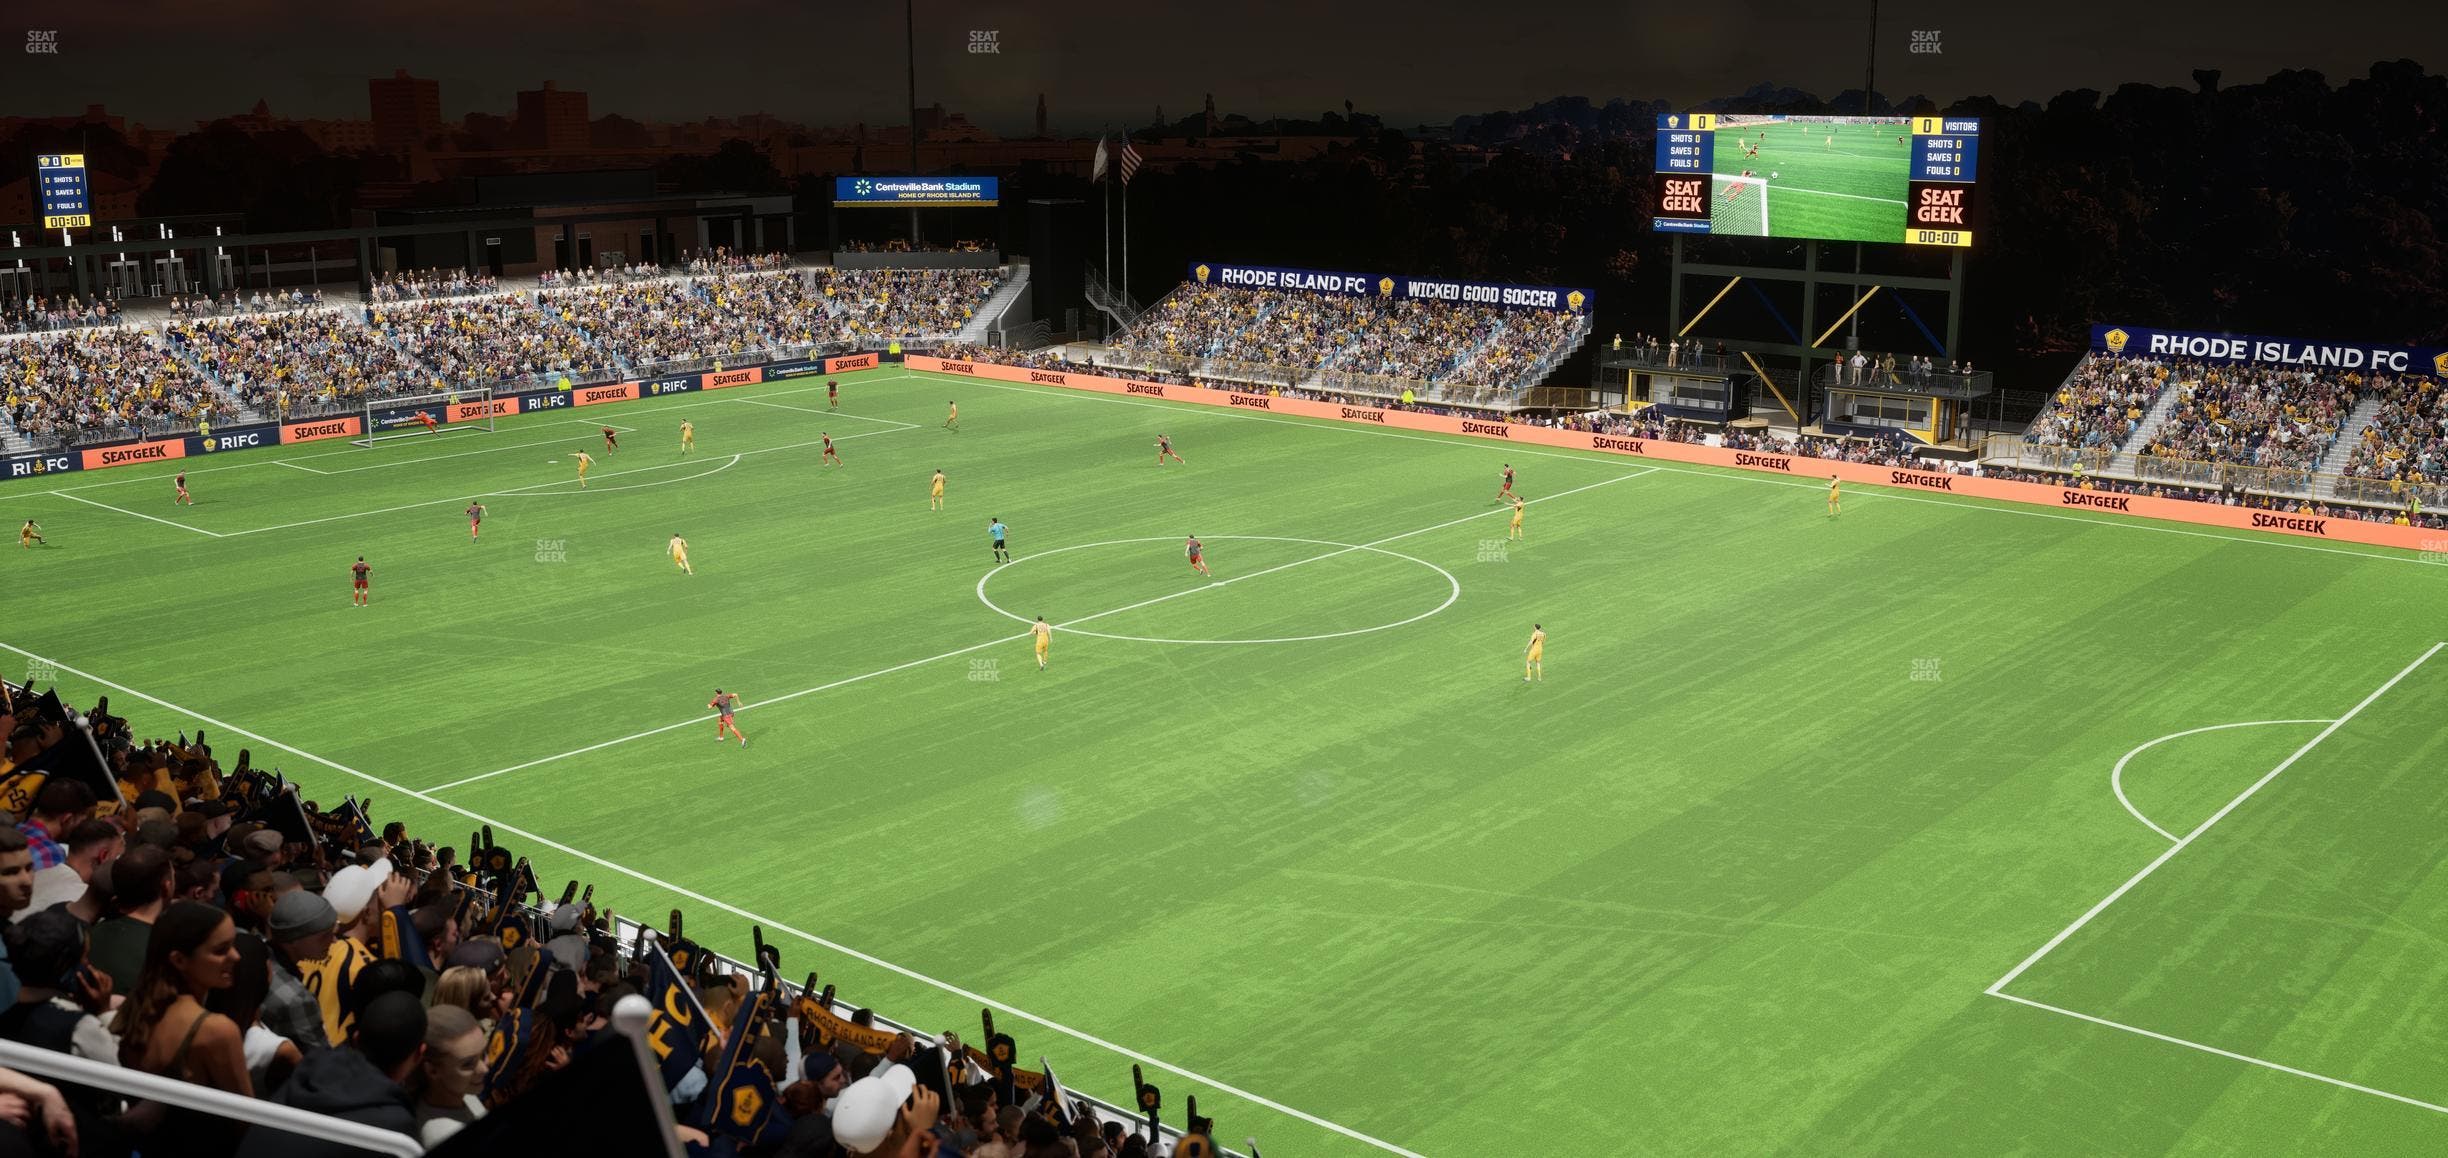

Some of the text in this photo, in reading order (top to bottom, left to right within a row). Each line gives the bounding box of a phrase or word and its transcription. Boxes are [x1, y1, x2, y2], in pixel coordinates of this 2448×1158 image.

[1699, 116, 1706, 129] 0
[1923, 119, 1978, 133] 0 VISITORS
[1670, 134, 1701, 143] SHOTS 0
[1928, 140, 1962, 149] SHOTS 0
[1670, 147, 1700, 156] SAVES 0
[1927, 153, 1961, 162] SAVES 0
[1670, 159, 1699, 168] FOULS 0
[1926, 166, 1960, 176] FOULS 0
[945, 183, 981, 191] Stadium
[1665, 179, 1702, 196] SEAT
[1663, 196, 1702, 213] GEEK
[1921, 188, 1964, 206] SEAT
[51, 216, 86, 227] 00:00
[1917, 206, 1964, 225] GEEK
[1919, 231, 1959, 244] 00:00
[1222, 268, 1366, 294] RHODE ISLAND FC
[1408, 281, 1557, 308] WICKED GOOD SOCCER
[2150, 334, 2409, 372] RHODE ISLAND FC
[836, 357, 869, 370] SEATGEEK
[941, 361, 974, 375] SEATGEEK
[662, 380, 688, 393] RIFC
[713, 372, 751, 386] SEATGEEK
[1031, 372, 1066, 386] SEATGEEK
[586, 387, 628, 402] SEATGEEK
[1127, 383, 1164, 397] SEATGEEK
[1230, 394, 1270, 410] SEATGEEK
[1342, 407, 1385, 424] SEATGEEK
[295, 422, 347, 440] SEATGEEK
[1462, 421, 1509, 438] SEATGEEK
[221, 433, 259, 450] RIFC
[1593, 436, 1644, 454] SEATGEEK
[102, 445, 167, 464] SEATGEEK
[1735, 453, 1791, 471] SEATGEEK
[46, 458, 69, 472] FC
[1891, 470, 1953, 491] SEATGEEK
[2063, 490, 2130, 512] SEATGEEK
[2252, 513, 2326, 535] SEATGEEK
